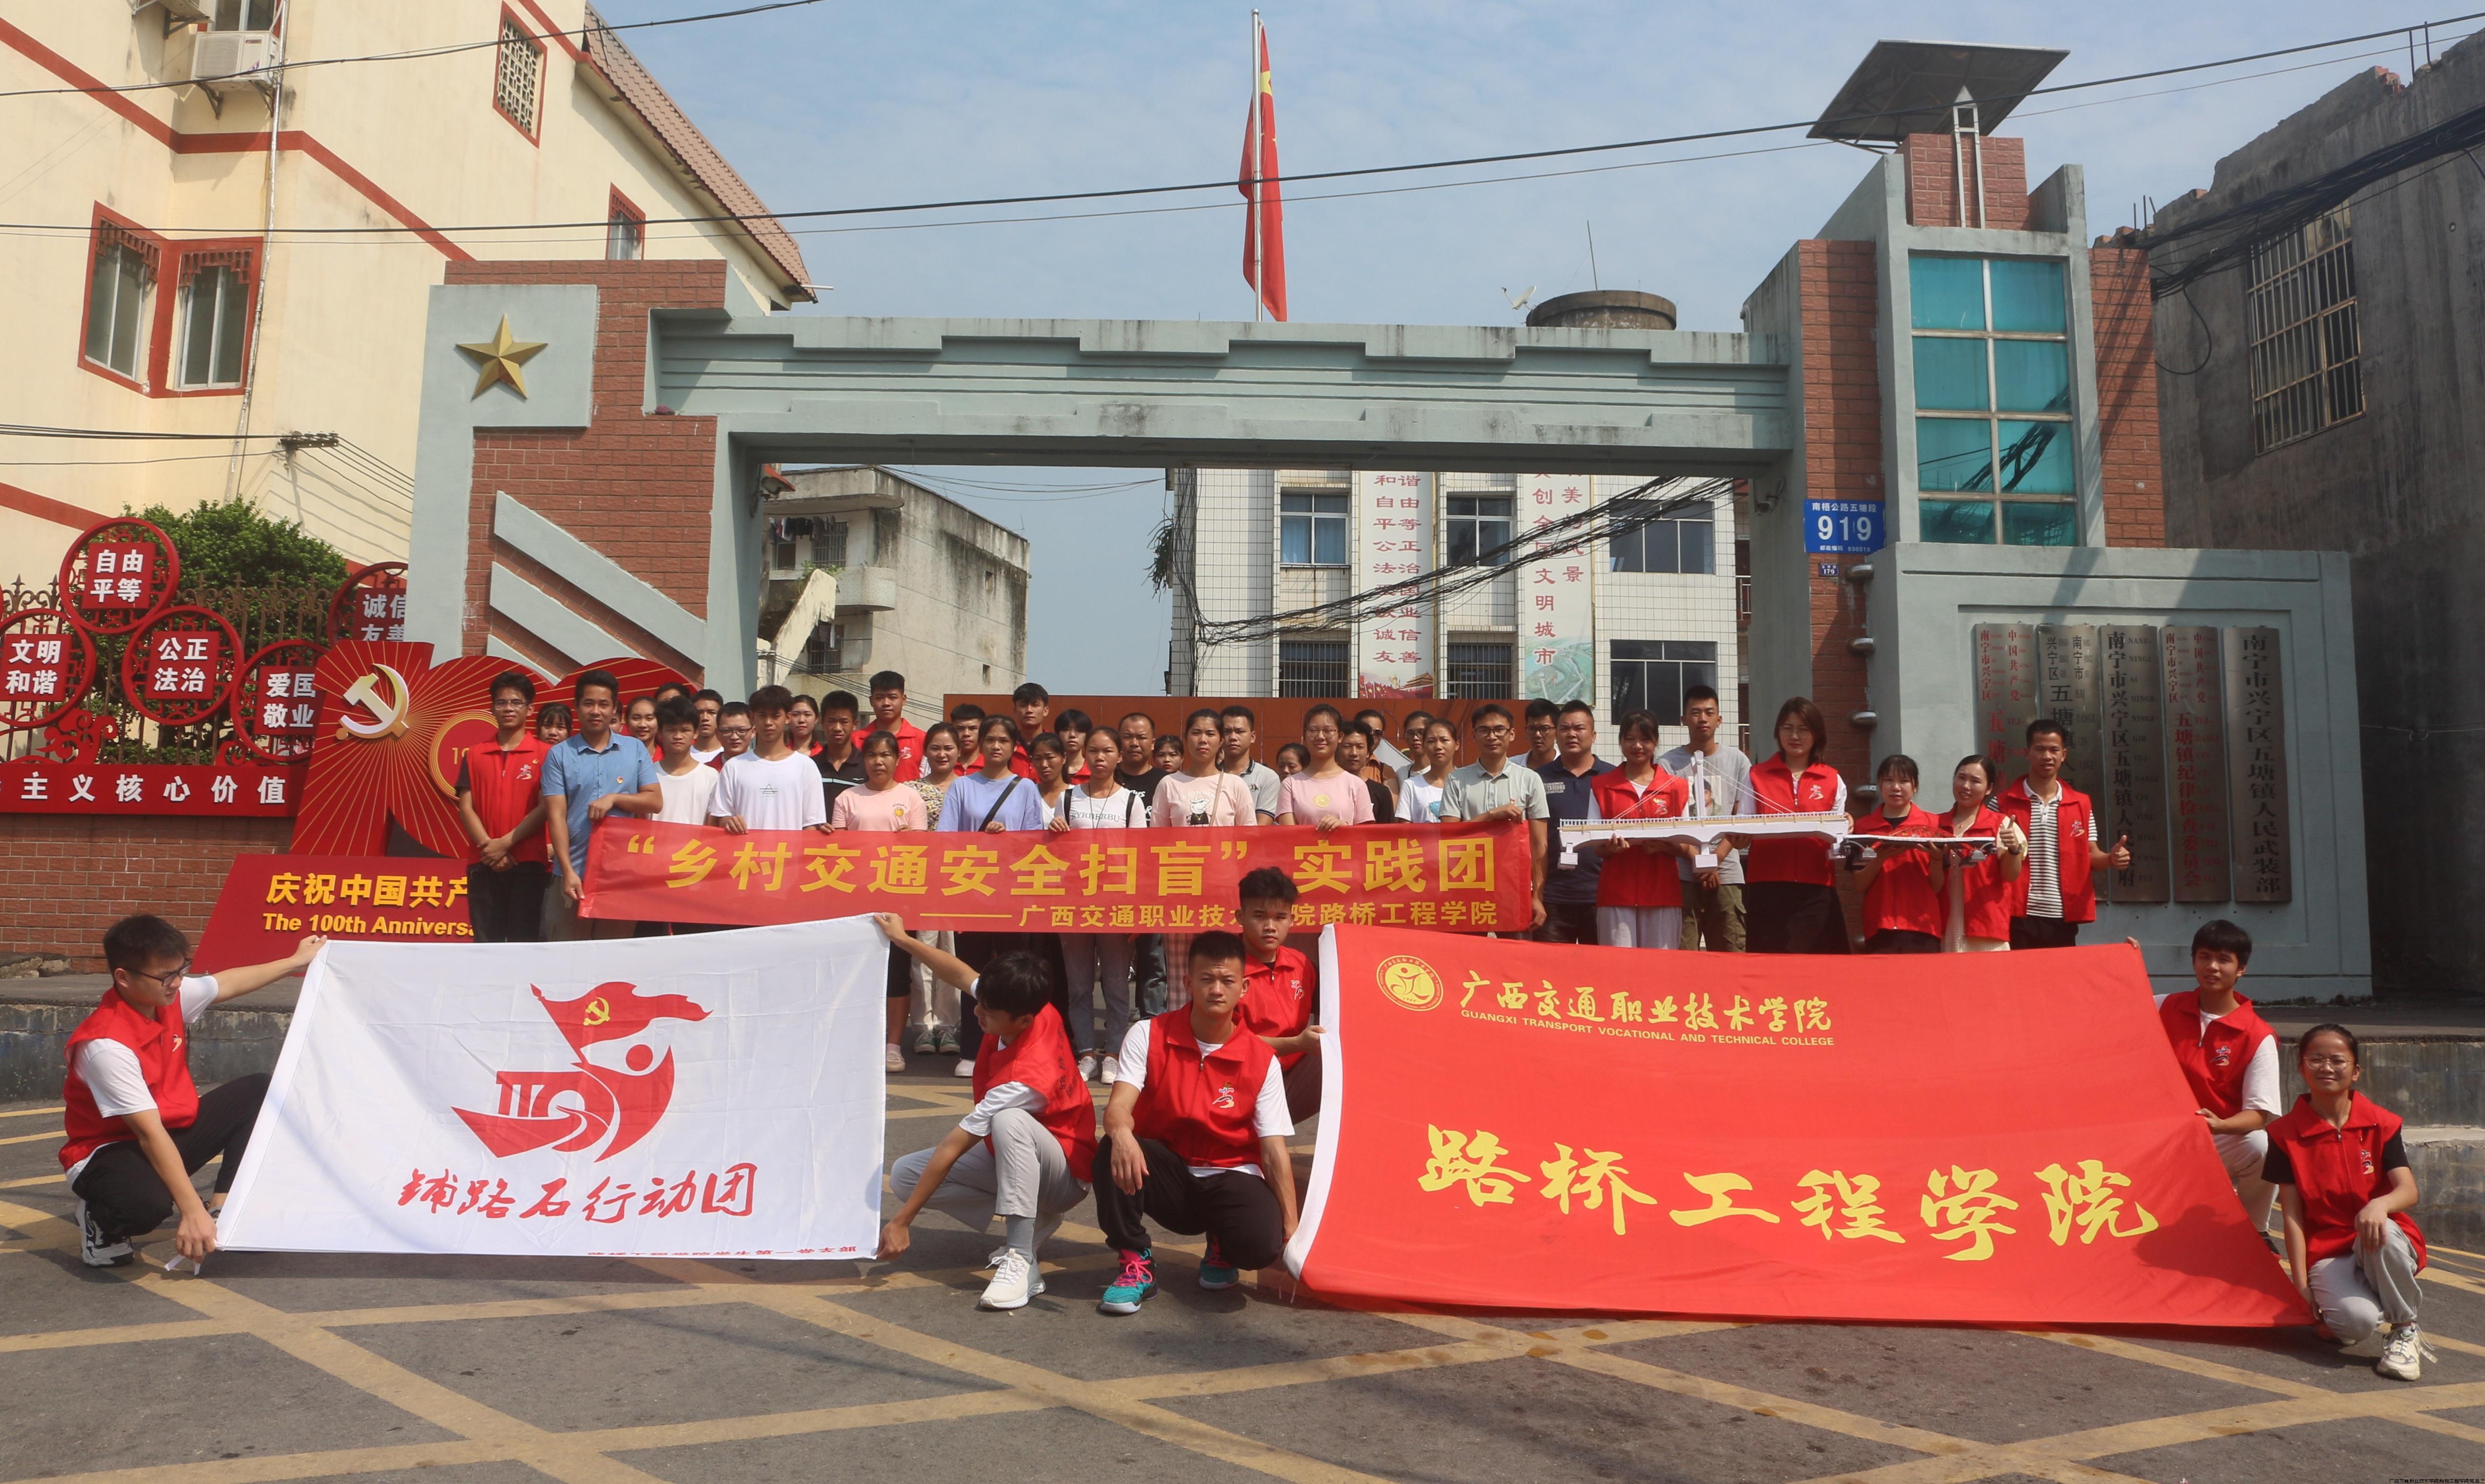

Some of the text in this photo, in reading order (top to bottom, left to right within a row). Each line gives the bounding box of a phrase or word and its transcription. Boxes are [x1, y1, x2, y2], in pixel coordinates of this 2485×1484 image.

[1373, 474, 1421, 487] 和谐
[1376, 496, 1420, 508] 自由
[1812, 502, 1877, 512] 南梧公路五塘段
[1373, 518, 1422, 530] 平等
[1817, 515, 1872, 541] 919
[1372, 540, 1422, 552] 公正
[96, 549, 143, 573] 自由
[1373, 562, 1420, 574] 法治
[90, 578, 142, 603] 平等
[363, 594, 406, 619] 诚信
[1373, 628, 1421, 641] 诚信
[9, 639, 61, 664] 文明
[158, 637, 209, 661] 公正
[1373, 650, 1422, 663] 友善
[2047, 637, 2059, 680] 兴宁区
[2072, 635, 2083, 680] 南宁市
[1981, 630, 1991, 701] 南宁市兴宁区
[2008, 630, 2019, 701] 中国共产党
[2166, 633, 2178, 703] 南宁市兴宁区
[2194, 632, 2206, 703] 中国共产党
[5, 669, 58, 694] 和谐
[154, 667, 206, 692] 法治
[266, 672, 315, 698] 爱国
[264, 703, 314, 728] 敬业
[2107, 631, 2135, 887] 南宁市兴宁区五塘镇人民府
[2242, 635, 2281, 894] 南宁市兴宁区五塘镇人民武装部
[21, 772, 285, 803] 主义核心价值
[2175, 712, 2201, 887] 五塘镇纪律检查委员会
[266, 872, 468, 908] 庆祝中国共产
[263, 913, 301, 931] The
[309, 914, 366, 934] 100th
[1019, 901, 1497, 928] 广西交通职业技院路桥工程学院
[1460, 970, 1831, 1033] 广西交通职业技术学院
[1461, 1009, 1835, 1045] GUANGXI TRANSPORT VOCATIONAL AND TECHNICAL COLLEGE
[397, 1162, 758, 1224] 铺路石行动团
[1418, 1124, 2159, 1261] 路桥工程学院
